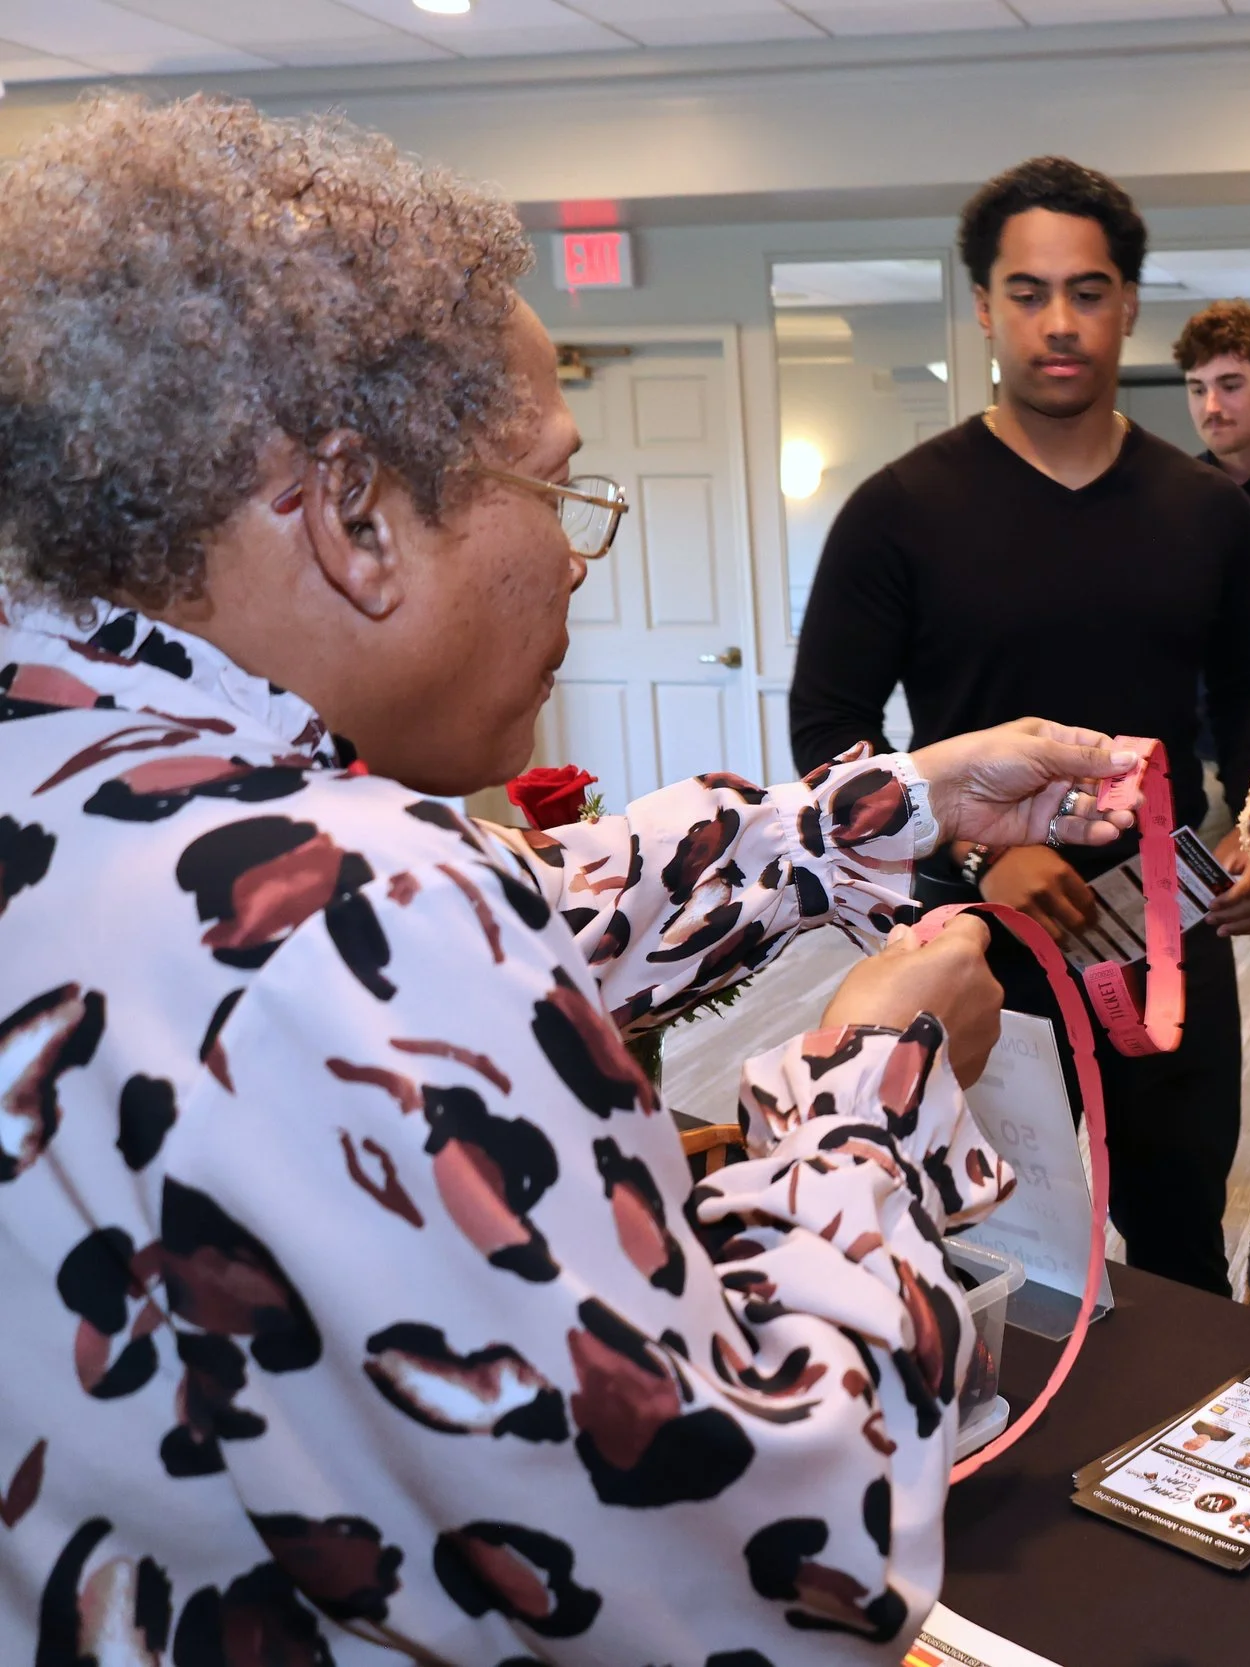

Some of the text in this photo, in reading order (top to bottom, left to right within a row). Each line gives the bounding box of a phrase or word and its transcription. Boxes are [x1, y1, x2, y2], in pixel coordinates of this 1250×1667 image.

[564, 233, 622, 285] EXIT
[1098, 982, 1125, 1021] TICKET
[1158, 1445, 1185, 1461] WINNERS
[1185, 1455, 1227, 1475] SCHOLARSHIP
[1092, 1490, 1245, 1556] Lonnie Winston Memorial Scholarship
[919, 1633, 964, 1662] REGISTRATION
